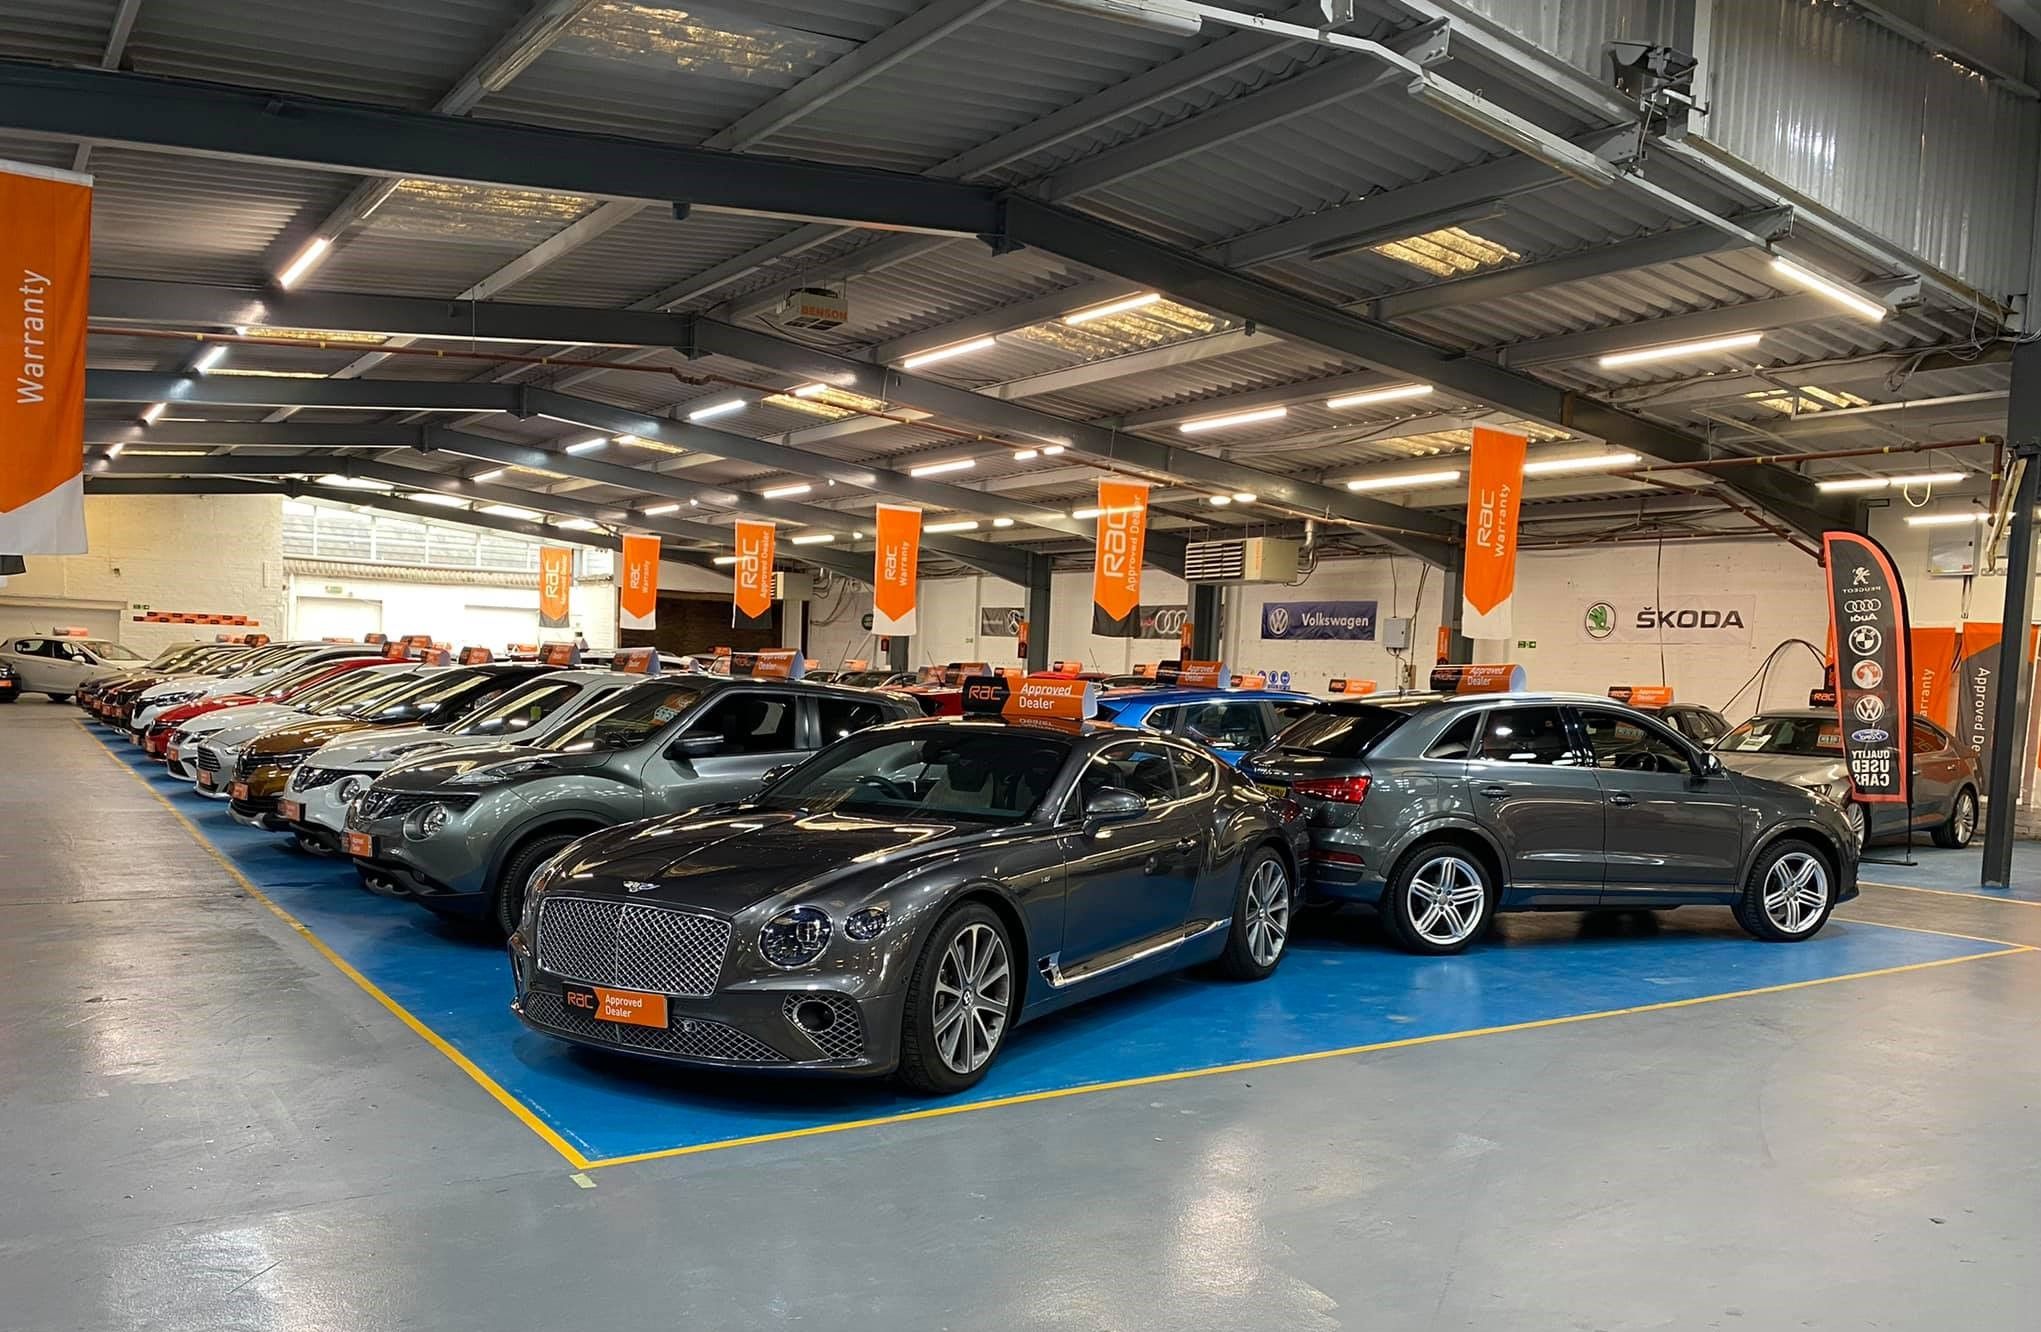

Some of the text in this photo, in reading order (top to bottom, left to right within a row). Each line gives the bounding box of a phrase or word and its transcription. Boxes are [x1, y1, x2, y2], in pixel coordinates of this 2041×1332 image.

[16, 269, 51, 404] Warranty
[1494, 483, 1511, 557] Warranty
[899, 540, 911, 587] Warranty
[1126, 536, 1138, 592] Approved
[1302, 612, 1369, 629] Volkswagen
[1636, 606, 1744, 628] ŠKODA
[1019, 696, 1054, 709] Dealer
[1020, 682, 1072, 697] Approved
[1920, 668, 1936, 718] arranty
[1973, 667, 1991, 731] Approved
[605, 994, 642, 1008] Approved
[605, 1006, 632, 1018] Dealer
